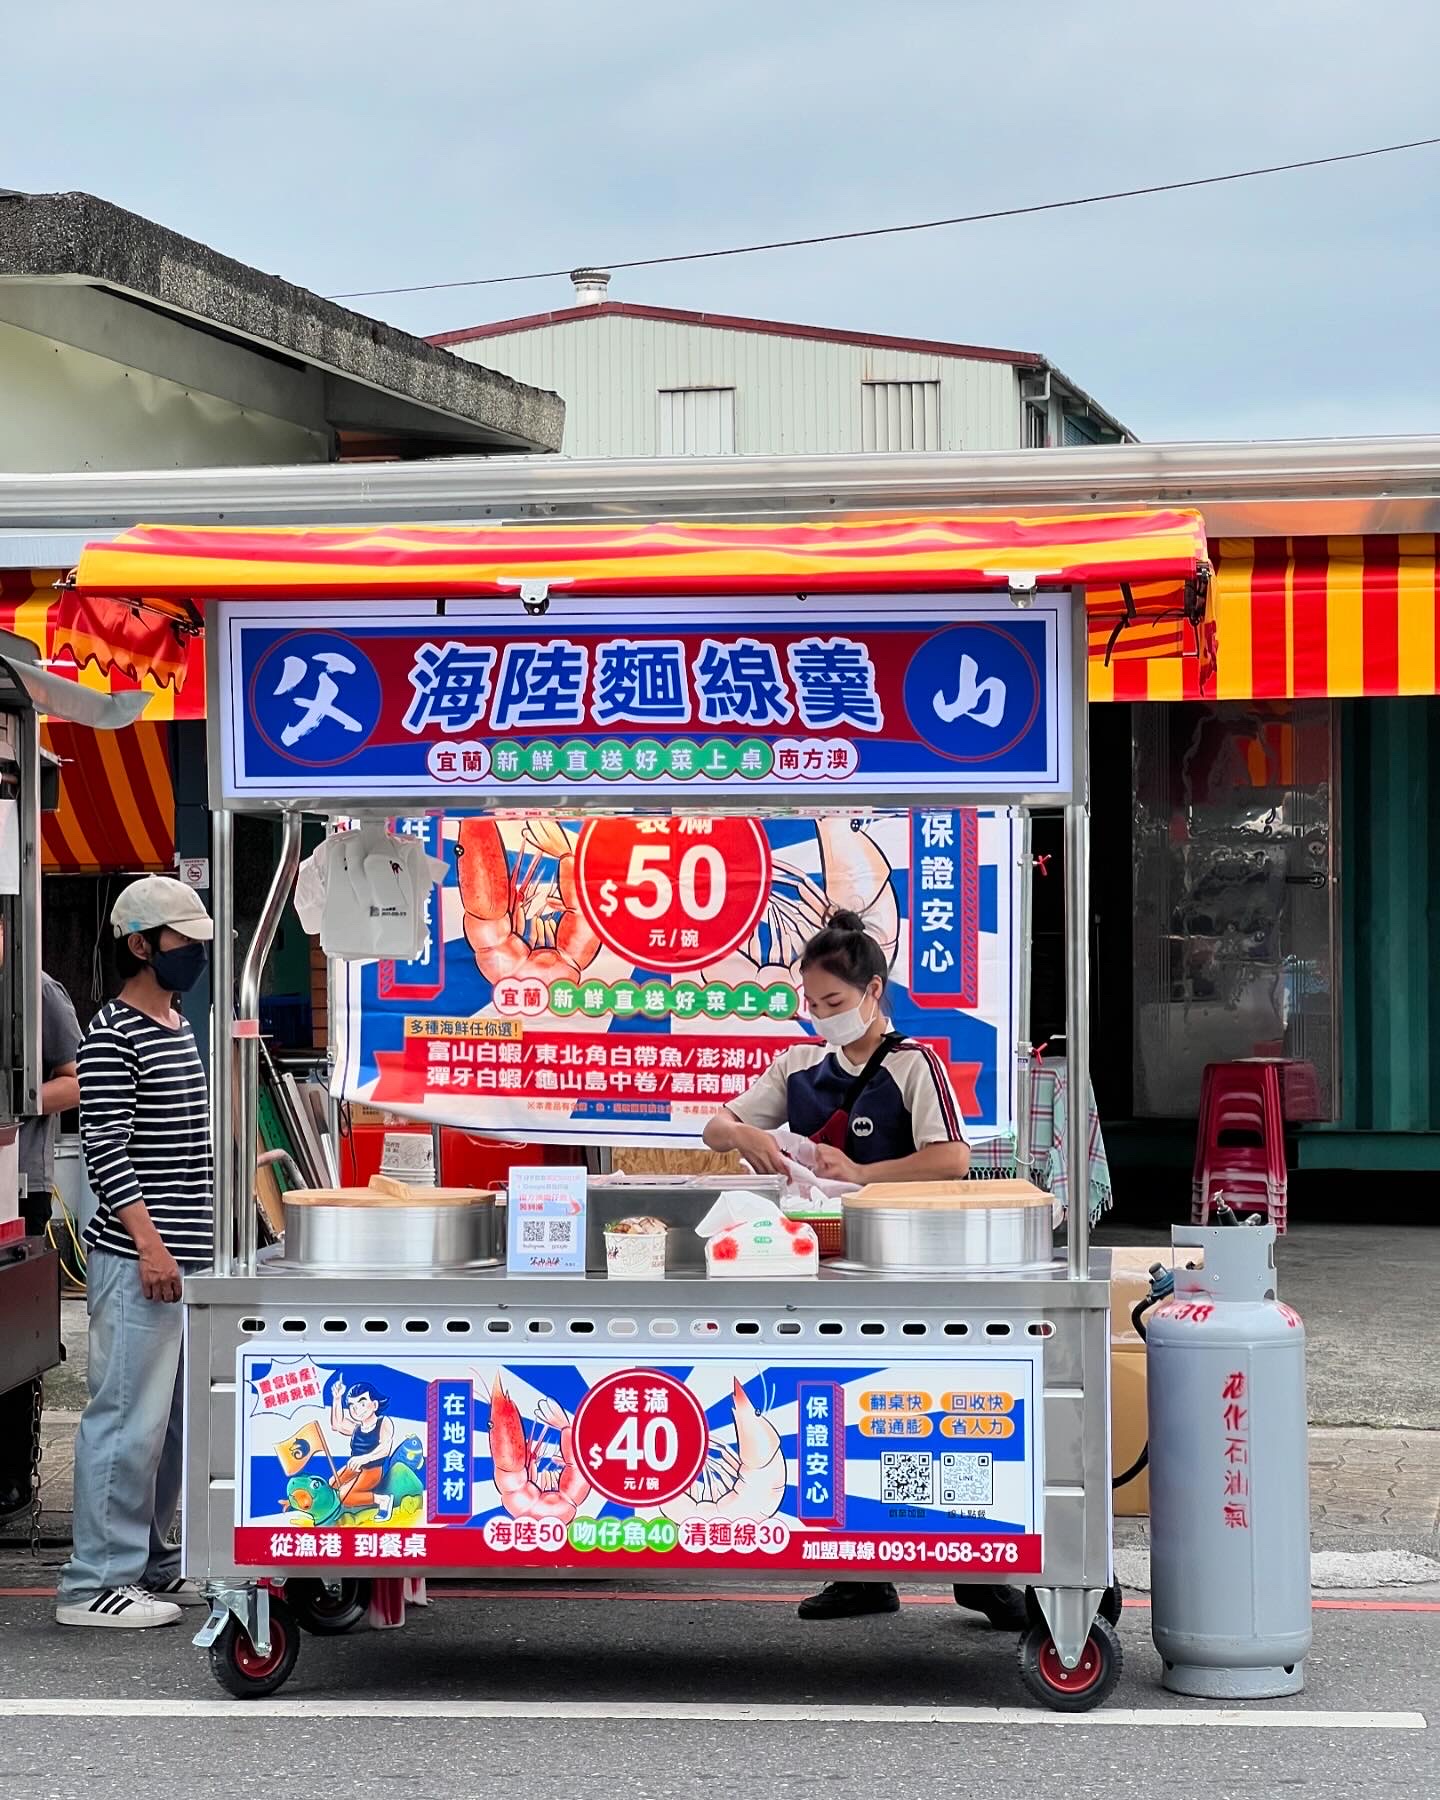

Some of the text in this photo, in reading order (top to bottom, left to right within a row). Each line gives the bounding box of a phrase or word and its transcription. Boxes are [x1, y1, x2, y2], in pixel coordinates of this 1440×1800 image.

[402, 637, 884, 734] 海陸麵線羹
[932, 654, 1007, 728] 山
[273, 652, 363, 747] 父
[436, 747, 849, 773] 宜蘭 新鮮直送好菜上桌 南方澳
[599, 844, 727, 921] $50
[921, 813, 954, 973] 保證安心
[649, 928, 699, 947] 元/碗
[501, 988, 541, 1007] 宜蘭
[554, 988, 788, 1012] 新鮮直送好菜上桌
[411, 1020, 518, 1037] 多種海鮮任你選!
[613, 1388, 668, 1413] 裝滿
[870, 1394, 922, 1410] 翻桌快
[952, 1395, 1003, 1410] 回收快
[952, 1418, 1003, 1435] 省人力
[443, 1394, 465, 1500] 在地食材
[589, 1417, 678, 1471] $40
[806, 1396, 828, 1504] 保證安心
[1222, 1372, 1248, 1529] 液化石油氣
[624, 1478, 659, 1490] 元/碗
[270, 1534, 426, 1557] 從漁港 到餐桌
[490, 1522, 785, 1546] 海陸50 吻仔魚40 清麵線30
[802, 1541, 1018, 1563] 加盟專線 0931-058-378
